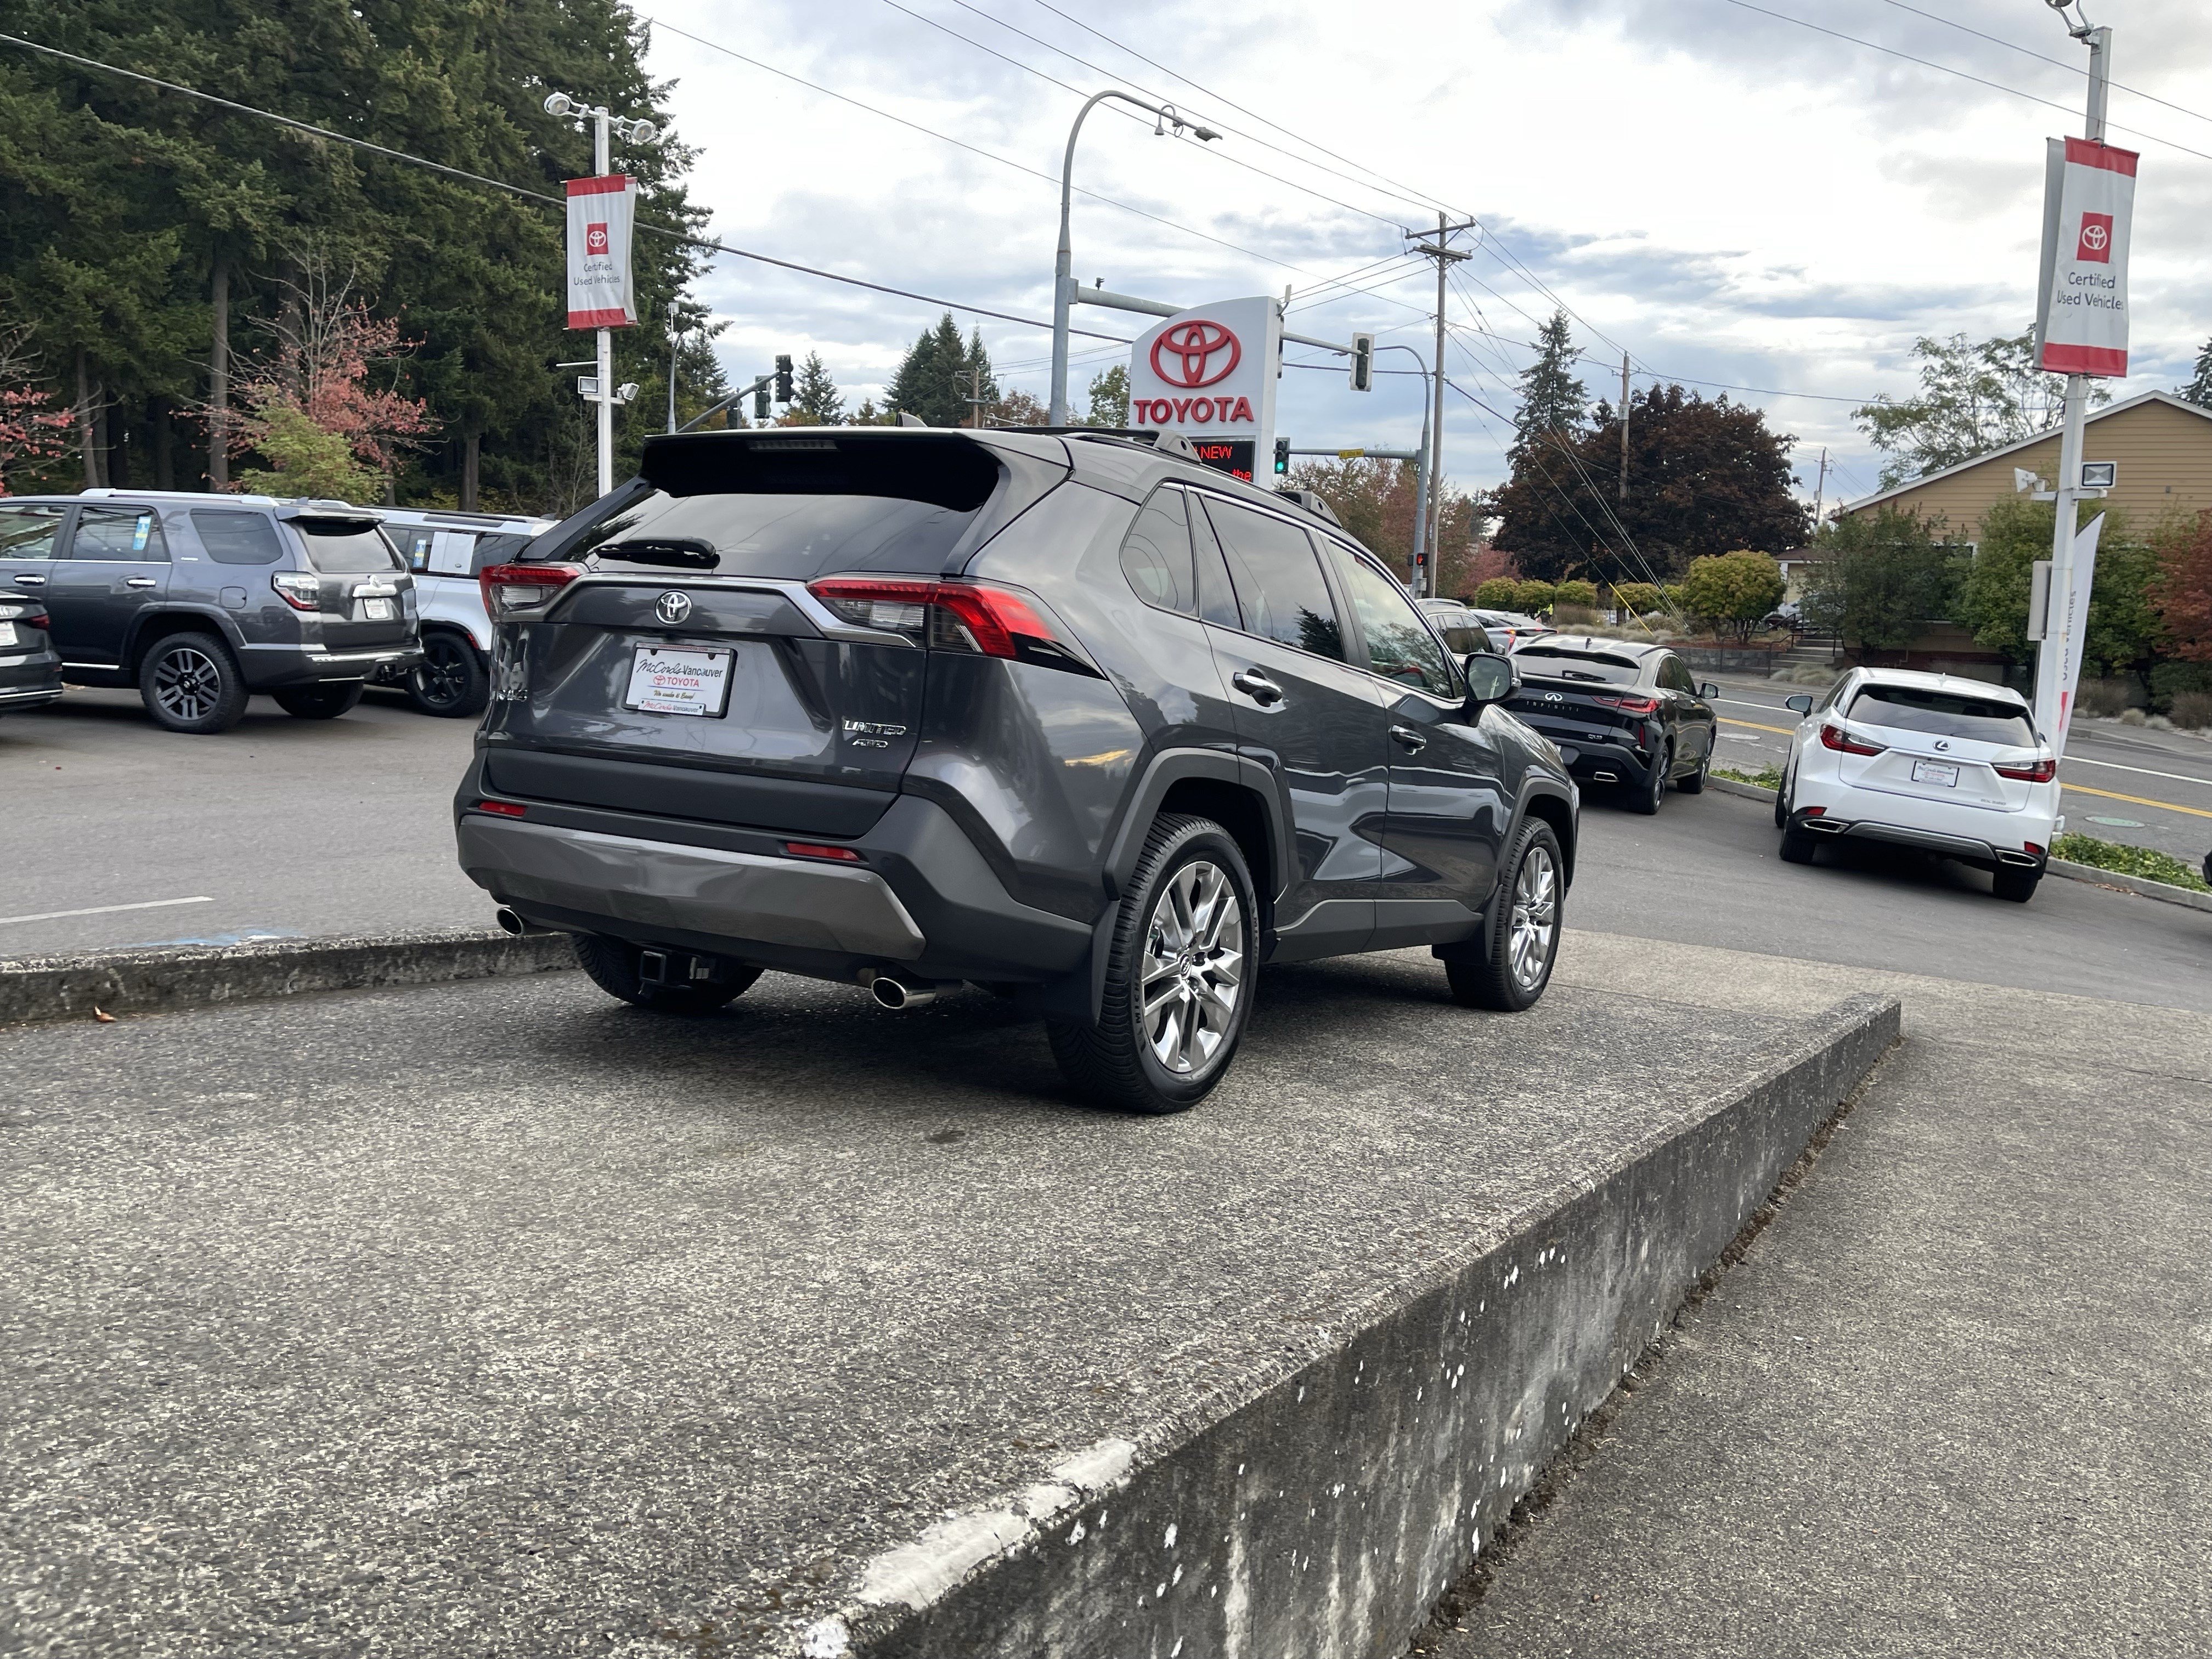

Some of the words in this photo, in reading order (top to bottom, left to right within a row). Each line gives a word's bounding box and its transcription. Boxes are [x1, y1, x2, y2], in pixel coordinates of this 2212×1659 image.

[574, 275, 592, 285] Used
[593, 275, 620, 284] Vehicles
[2068, 272, 2116, 289] Certified
[2057, 290, 2081, 305] Used
[2085, 293, 2124, 311] Vehicles
[1133, 396, 1255, 424] TOYOTA
[1200, 445, 1233, 459] NEW
[667, 676, 699, 687] TOYOTA
